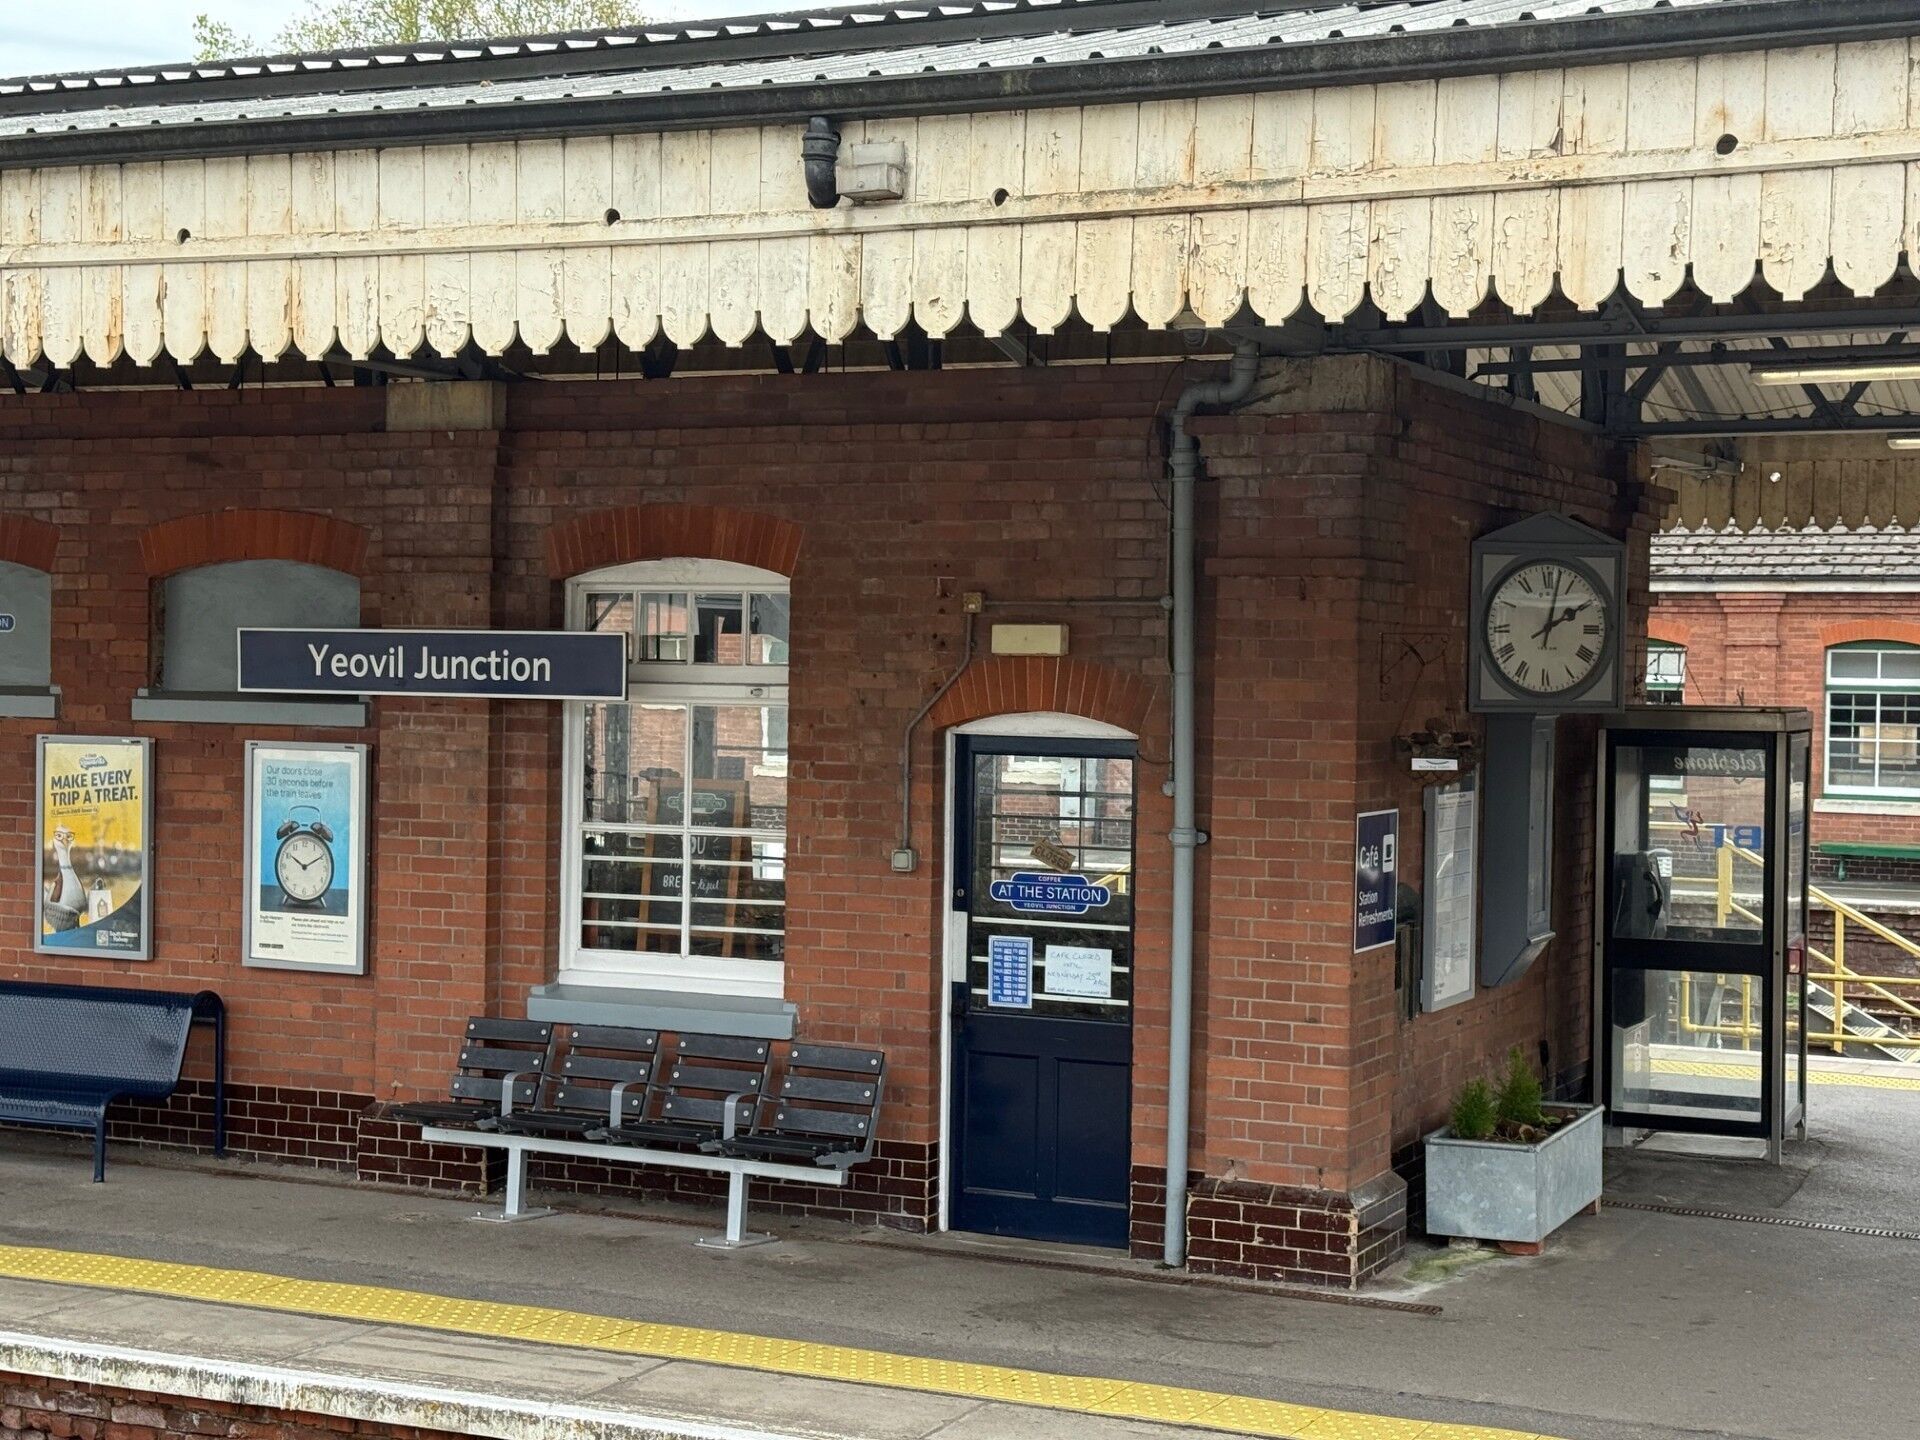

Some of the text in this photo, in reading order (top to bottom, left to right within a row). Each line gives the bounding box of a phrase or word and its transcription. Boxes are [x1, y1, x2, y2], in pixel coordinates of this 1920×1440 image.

[307, 643, 551, 682] Yeovil Junction
[51, 769, 133, 790] MAKE EVERY
[266, 765, 323, 776] Our doors close
[266, 777, 333, 788] 30 seconds before
[51, 786, 138, 807] TRIP A TREAT.
[266, 789, 280, 797] the
[280, 790, 297, 798] train
[1034, 847, 1071, 872] CLOSED
[1360, 845, 1379, 869] Café
[998, 884, 1101, 902] AT THE STATION
[1359, 891, 1378, 905] Station
[1358, 907, 1394, 927] Refreshments
